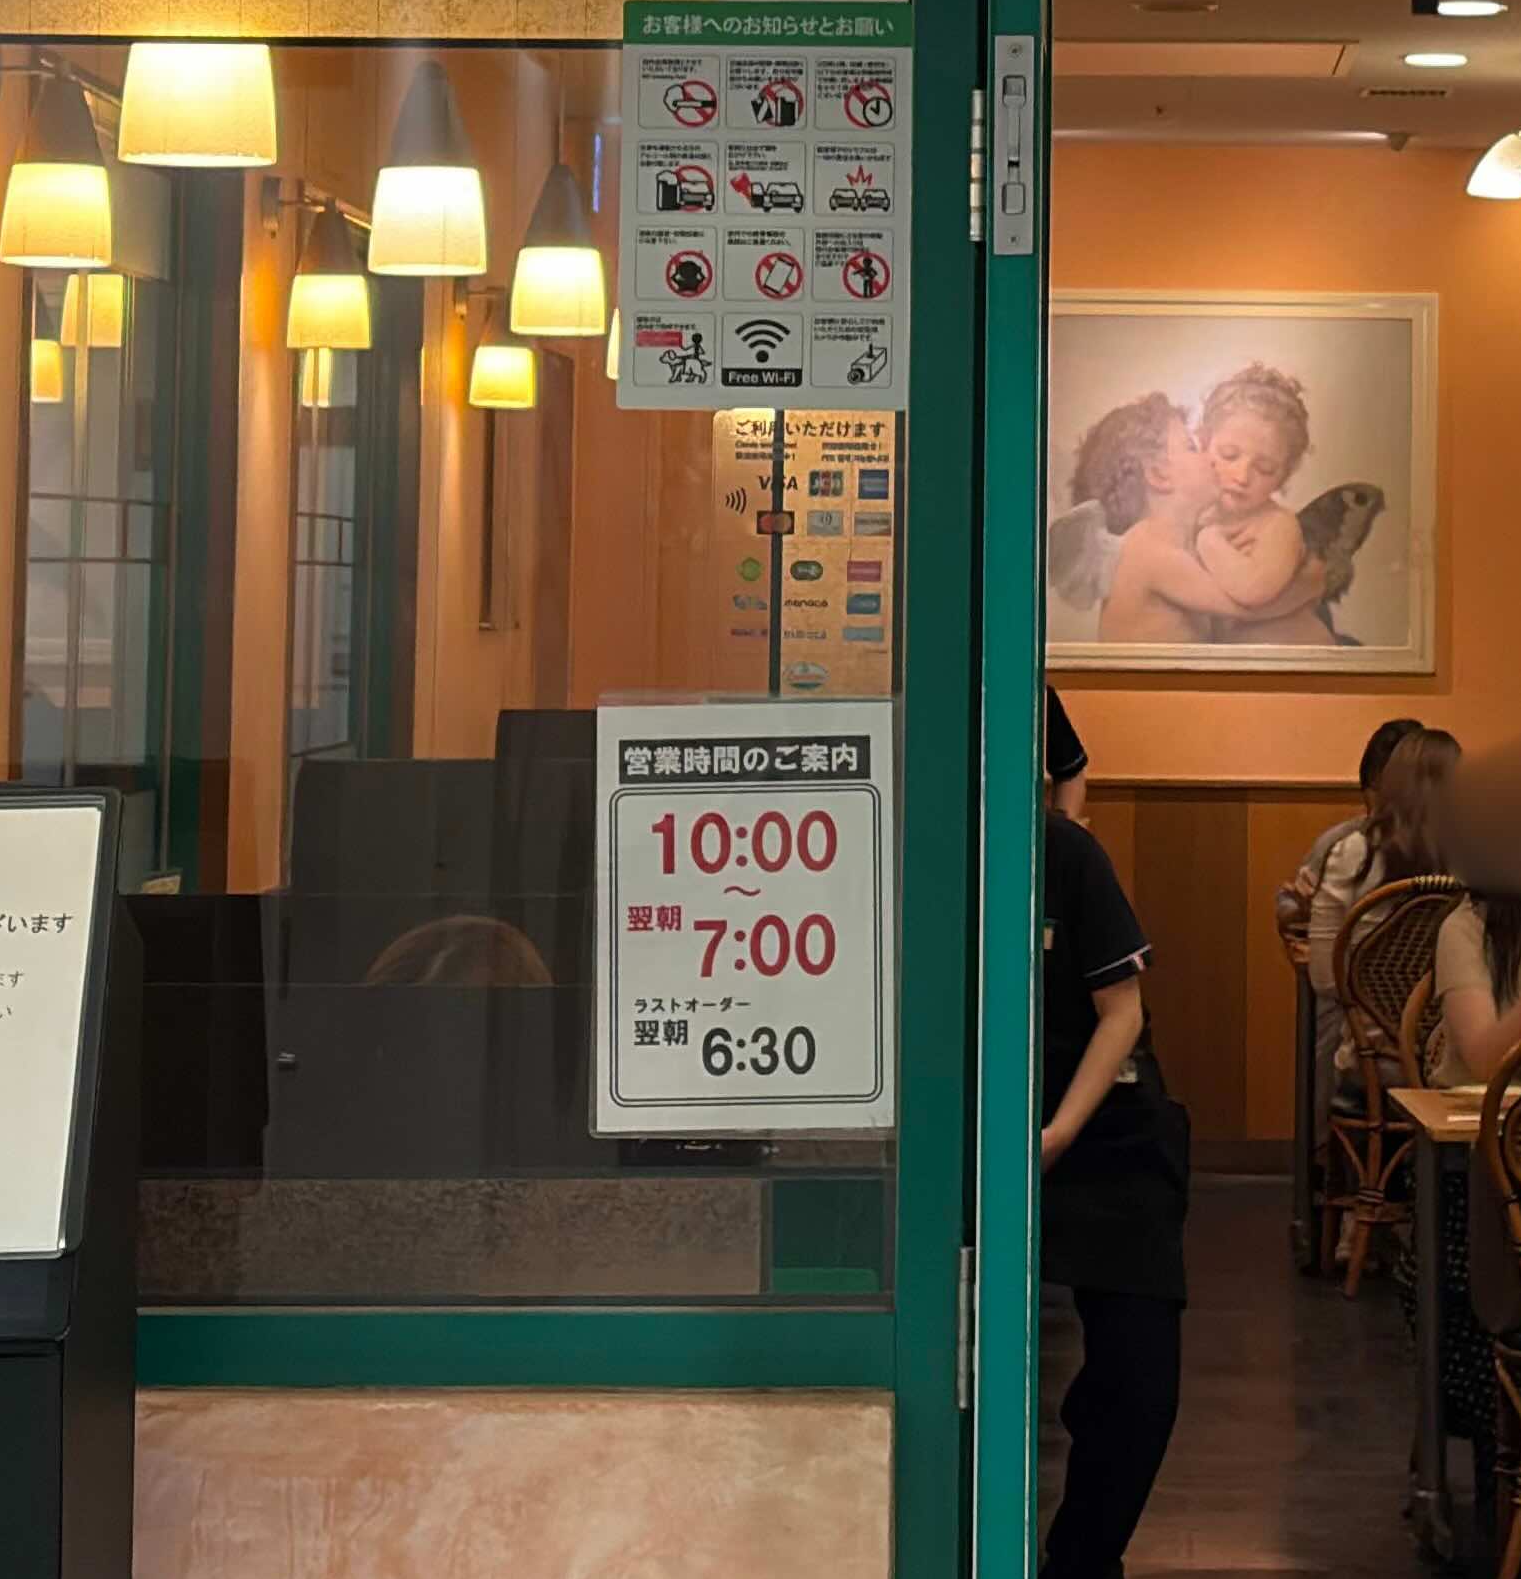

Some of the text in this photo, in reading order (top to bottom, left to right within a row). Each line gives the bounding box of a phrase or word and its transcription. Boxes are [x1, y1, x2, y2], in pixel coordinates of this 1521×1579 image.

[642, 13, 895, 37] お客様へのお知らせとお願い
[728, 371, 796, 384] Free Wi-Fi
[759, 475, 798, 491] VA
[623, 743, 858, 776] 営業時間のご案内
[651, 810, 838, 875] 10:00
[626, 904, 837, 978] 翌朝 7:00
[634, 997, 752, 1014] ラストオーダー
[633, 1019, 816, 1077] 翌朝 6:30
